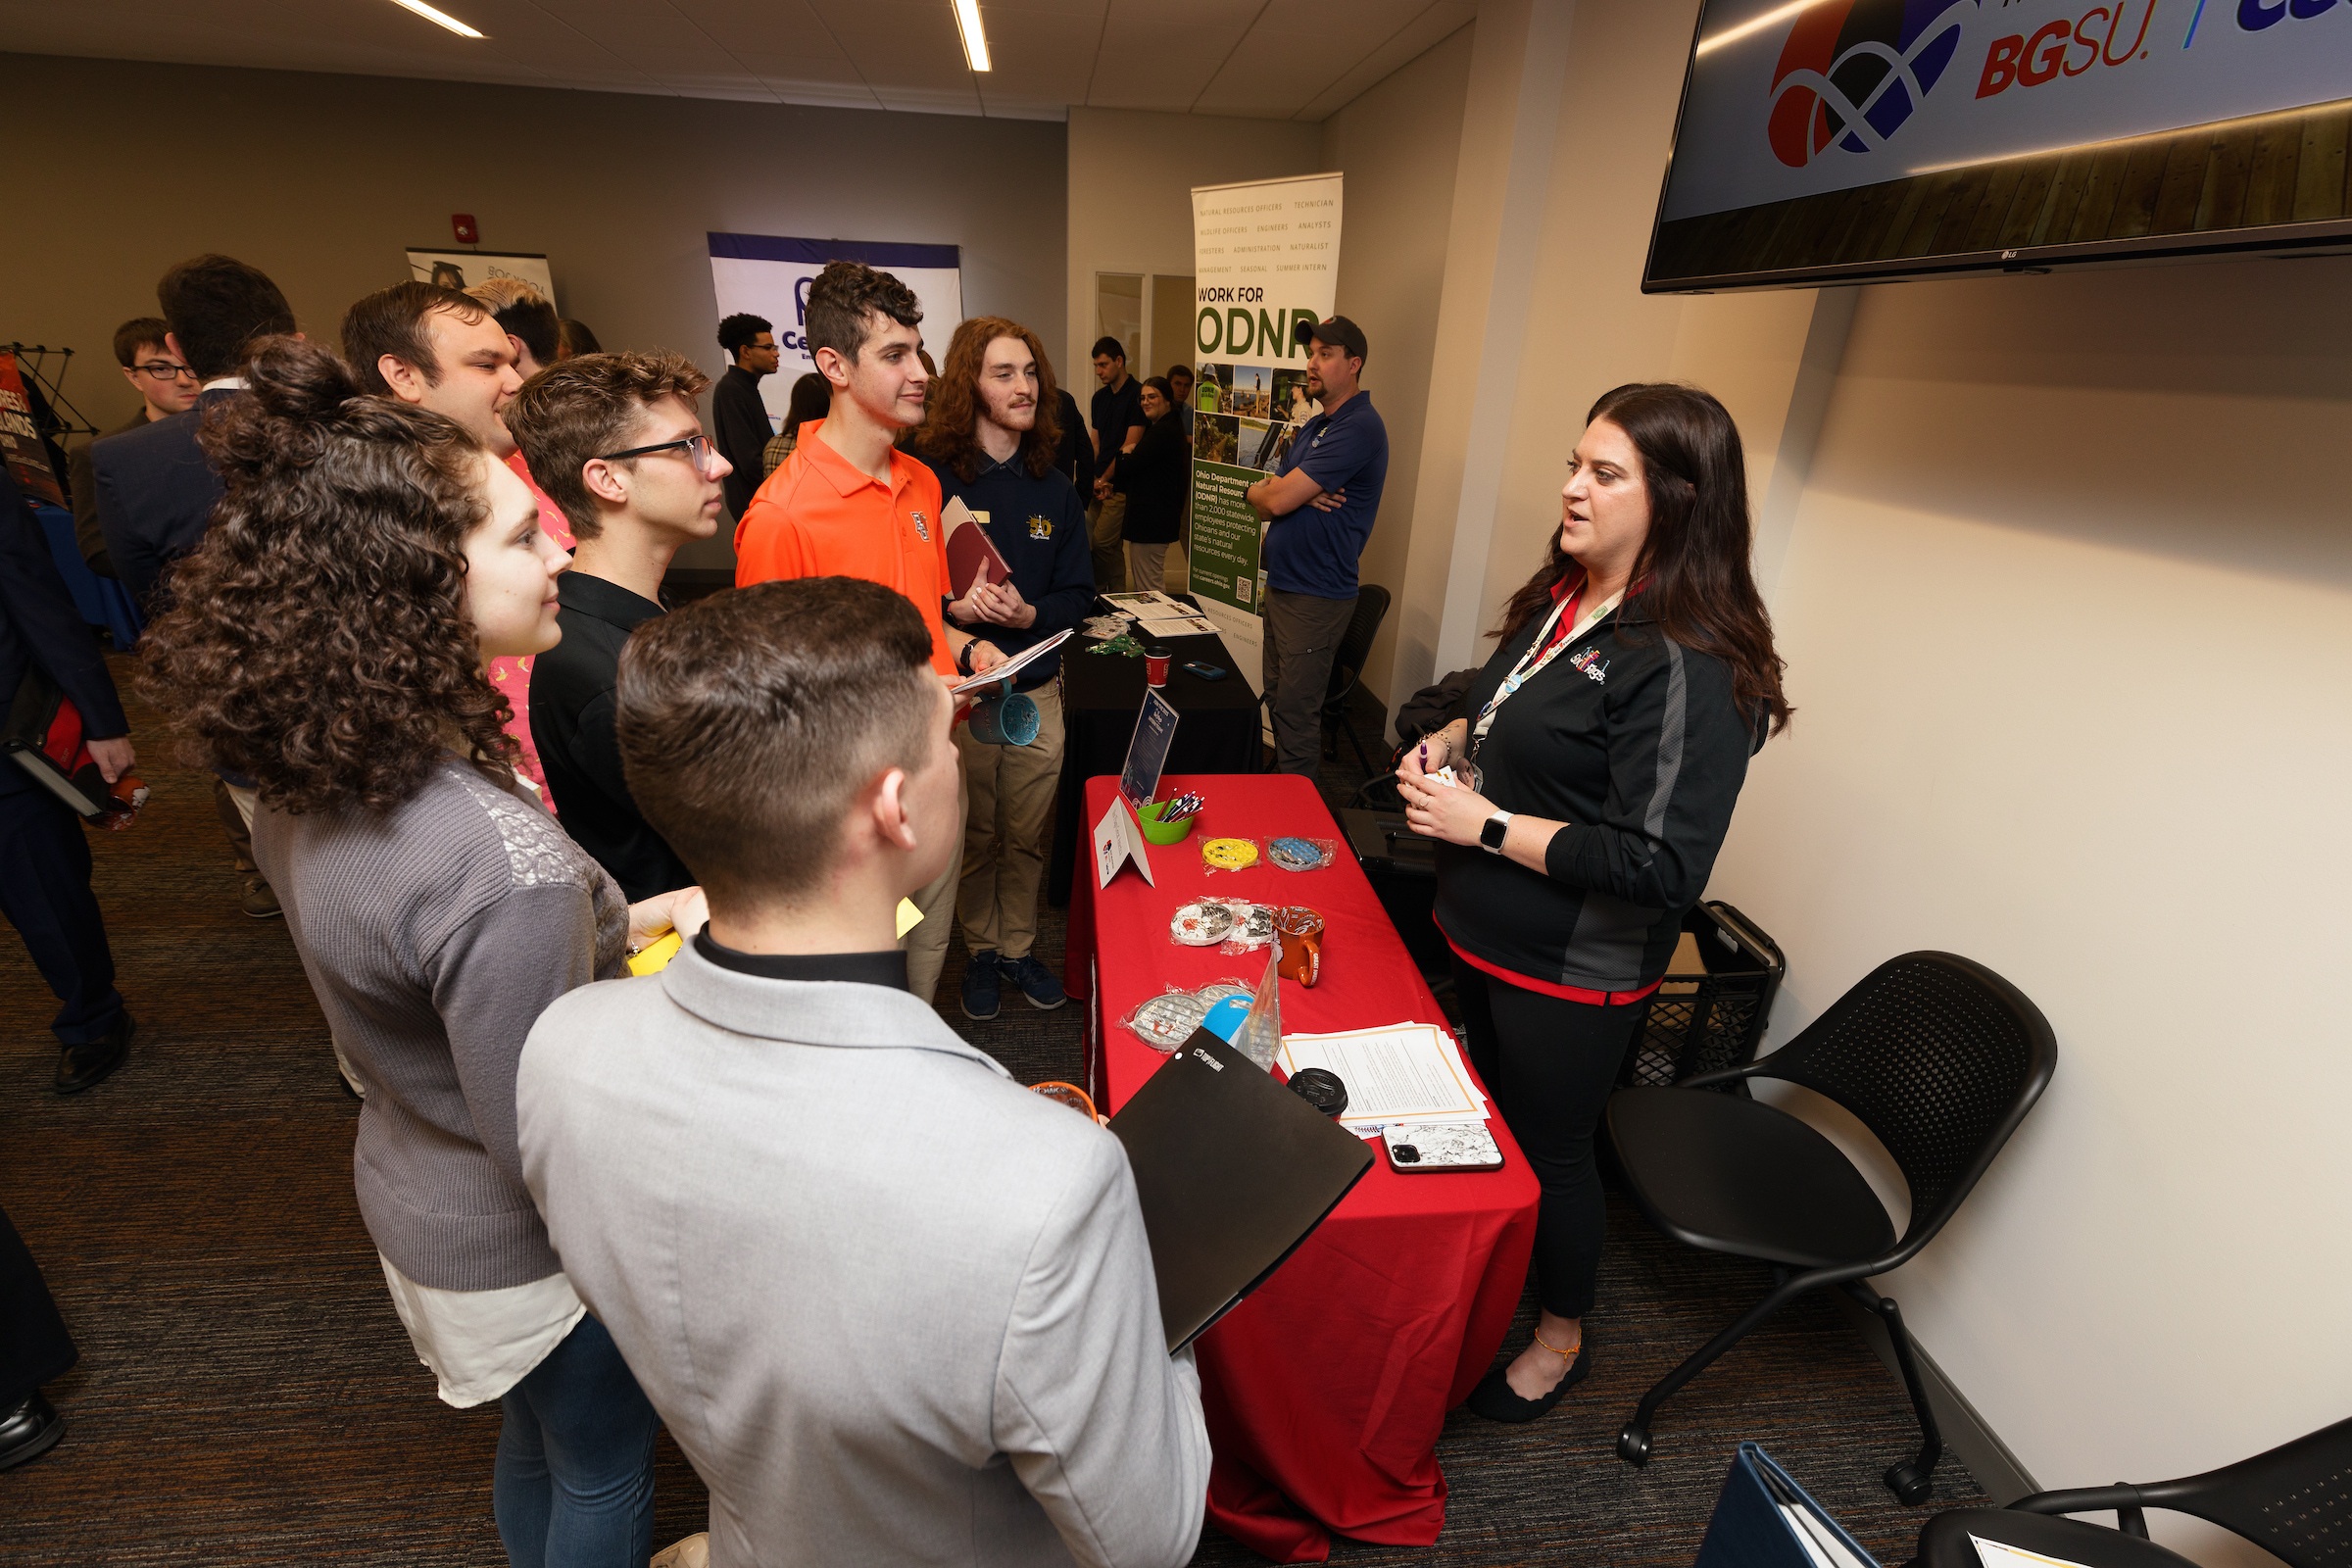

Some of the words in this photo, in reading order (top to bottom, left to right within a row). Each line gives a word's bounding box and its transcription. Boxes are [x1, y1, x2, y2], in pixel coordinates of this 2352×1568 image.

[1200, 208, 1221, 217] NATURAL
[1255, 203, 1283, 212] OFFICERS
[1294, 199, 1334, 209] TECHNICIAN
[1222, 225, 1248, 234] OFFICERS
[1256, 223, 1289, 232] ENGINEERS
[1298, 220, 1332, 229] ANALYSTS
[1233, 244, 1281, 254] ADMINISTRATION
[1290, 242, 1329, 251] NATURALIST
[1198, 287, 1235, 302] WORK
[1237, 287, 1264, 303] FOR
[1197, 306, 1319, 359] ODNR
[1196, 469, 1210, 479] Ohio
[1210, 472, 1250, 488] Department
[1196, 480, 1218, 492] Natural
[1218, 485, 1245, 499] Resourc
[1195, 490, 1218, 505] (ODNR)
[1218, 495, 1230, 506] has
[1230, 500, 1246, 510] more
[1195, 501, 1208, 512] than
[1208, 505, 1226, 515] 2,000
[1226, 510, 1254, 523] statewide
[1194, 513, 1226, 526] employees
[1226, 520, 1256, 537] protecting
[1194, 521, 1218, 535] Ohioans
[1218, 529, 1231, 538] and
[1230, 532, 1242, 541] our
[1193, 533, 1212, 544] state's
[1211, 539, 1233, 550] natural
[1193, 543, 1221, 557] resources
[1220, 551, 1237, 564] every
[1236, 555, 1250, 566] day.
[1207, 607, 1232, 621] RESOURCES
[1232, 616, 1253, 629] OFFICERS
[1233, 632, 1258, 647] ENGINEERS
